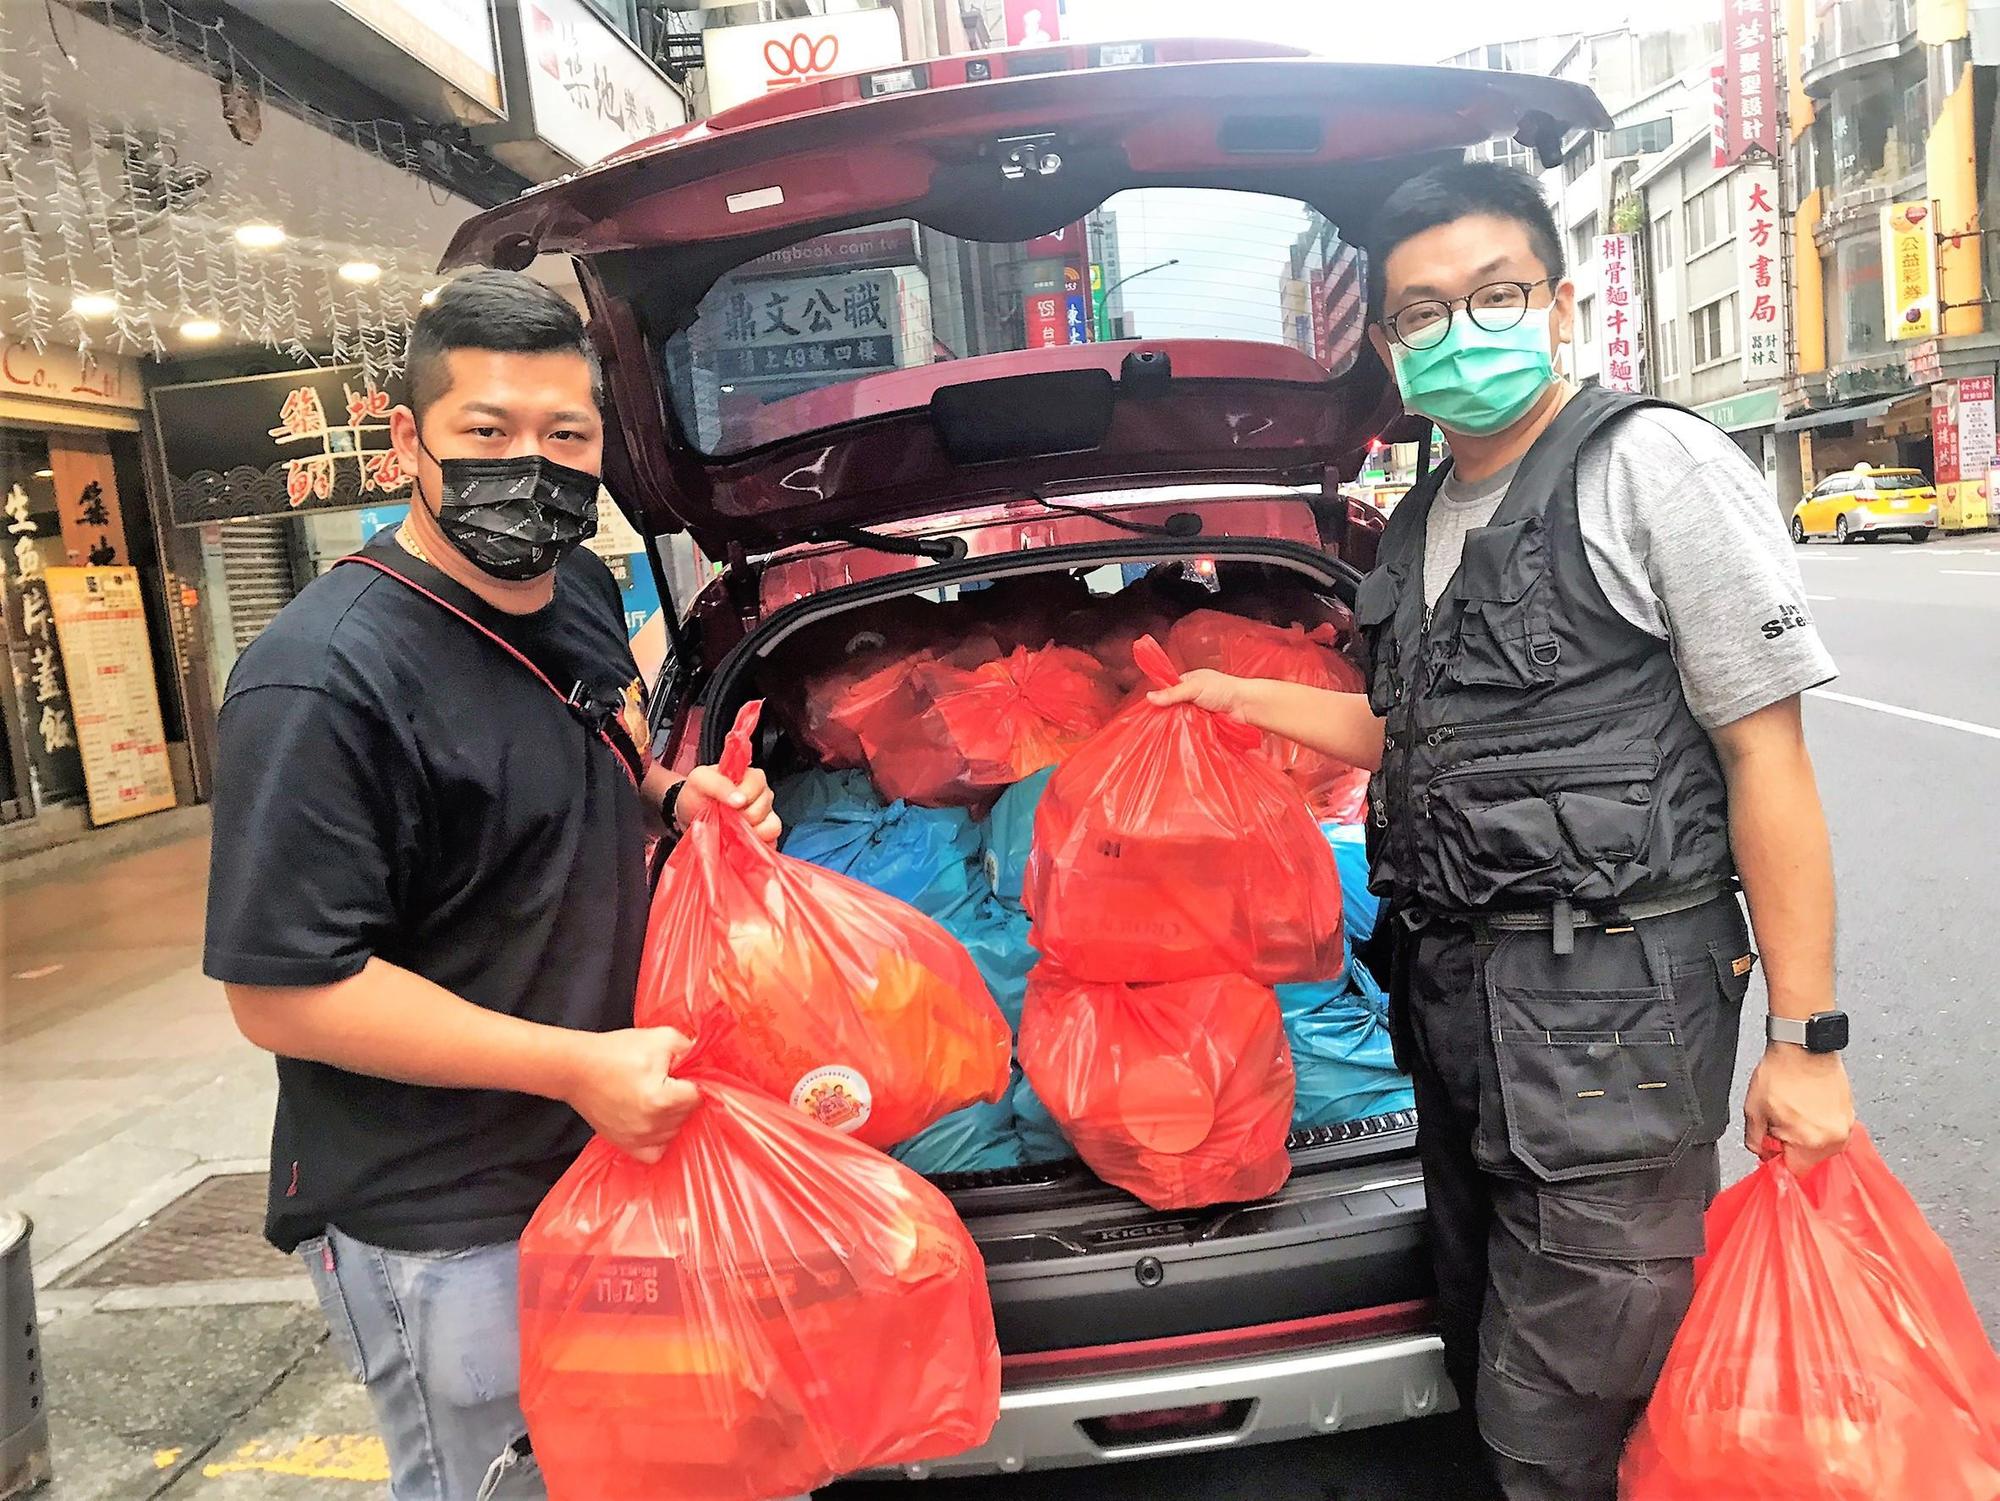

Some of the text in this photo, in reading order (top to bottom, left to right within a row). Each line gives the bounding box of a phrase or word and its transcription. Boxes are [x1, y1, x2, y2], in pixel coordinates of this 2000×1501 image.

[1749, 182, 1776, 323] 大方書局
[725, 281, 887, 341] 鼎文公職
[1602, 237, 1633, 381] 排骨麵牛肉麵
[1717, 405, 1734, 425] ATM
[1102, 1224, 1185, 1240] KICKS
